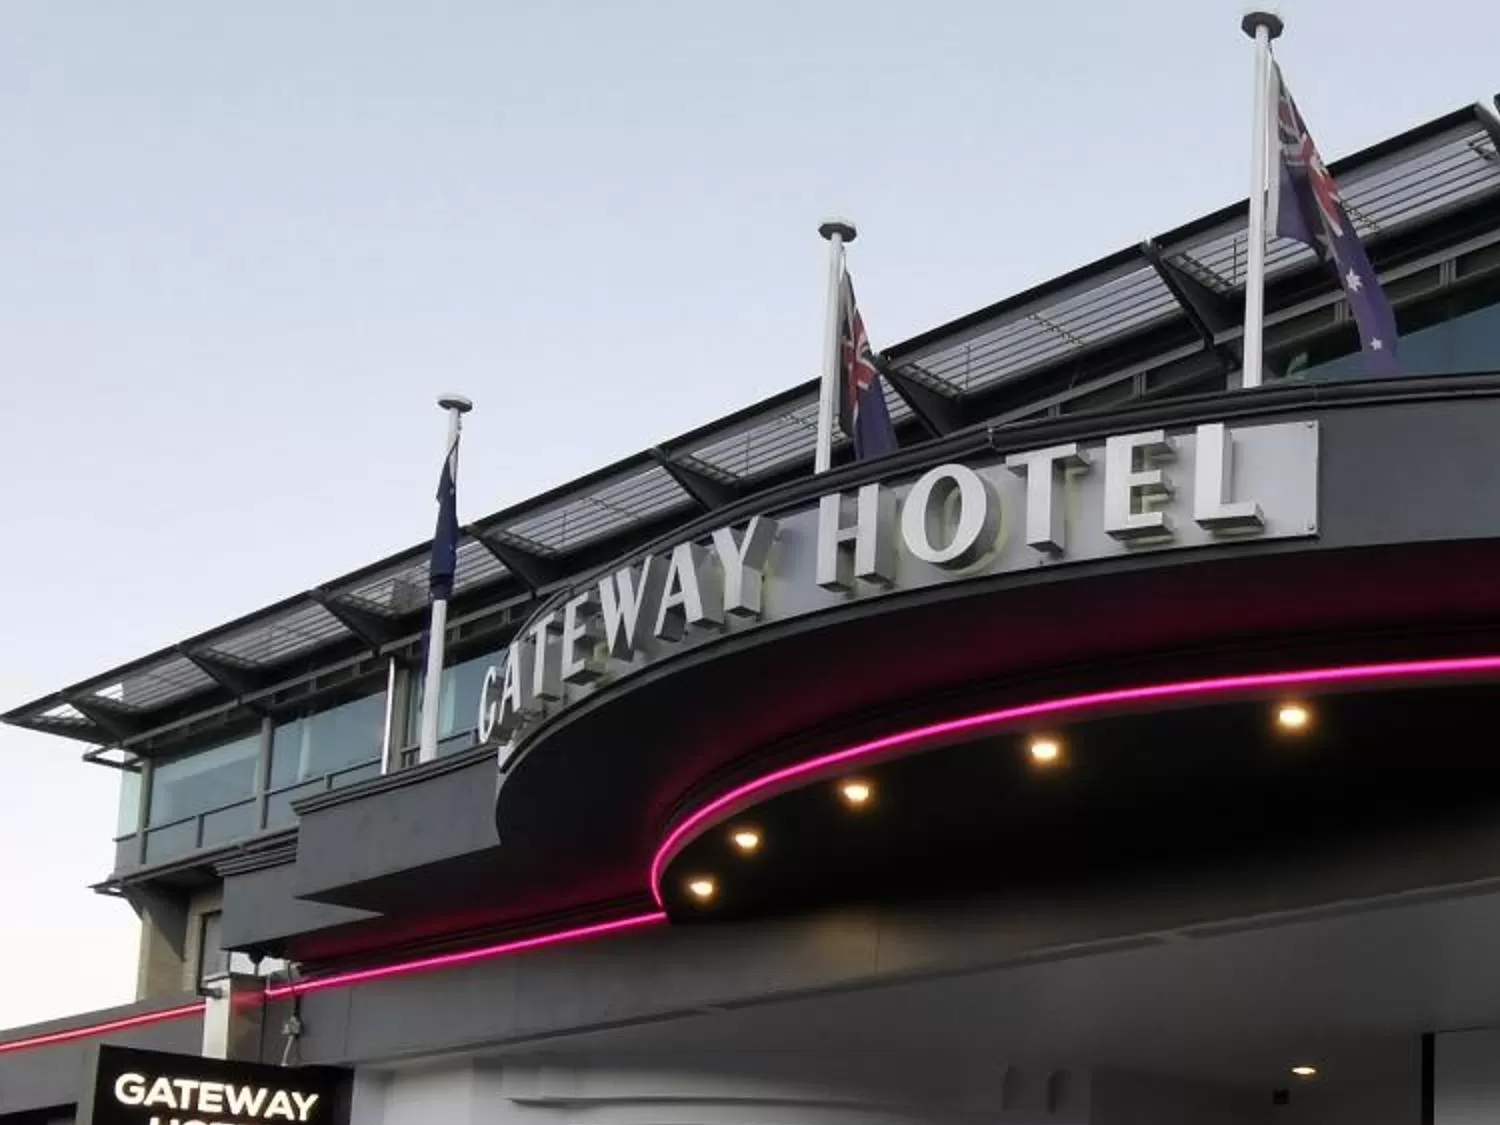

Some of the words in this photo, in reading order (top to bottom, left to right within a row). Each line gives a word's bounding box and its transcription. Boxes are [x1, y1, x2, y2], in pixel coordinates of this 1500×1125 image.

[478, 514, 782, 743] GATEWAY
[815, 423, 1266, 592] HOTEL
[114, 1072, 319, 1122] GATEWAY
